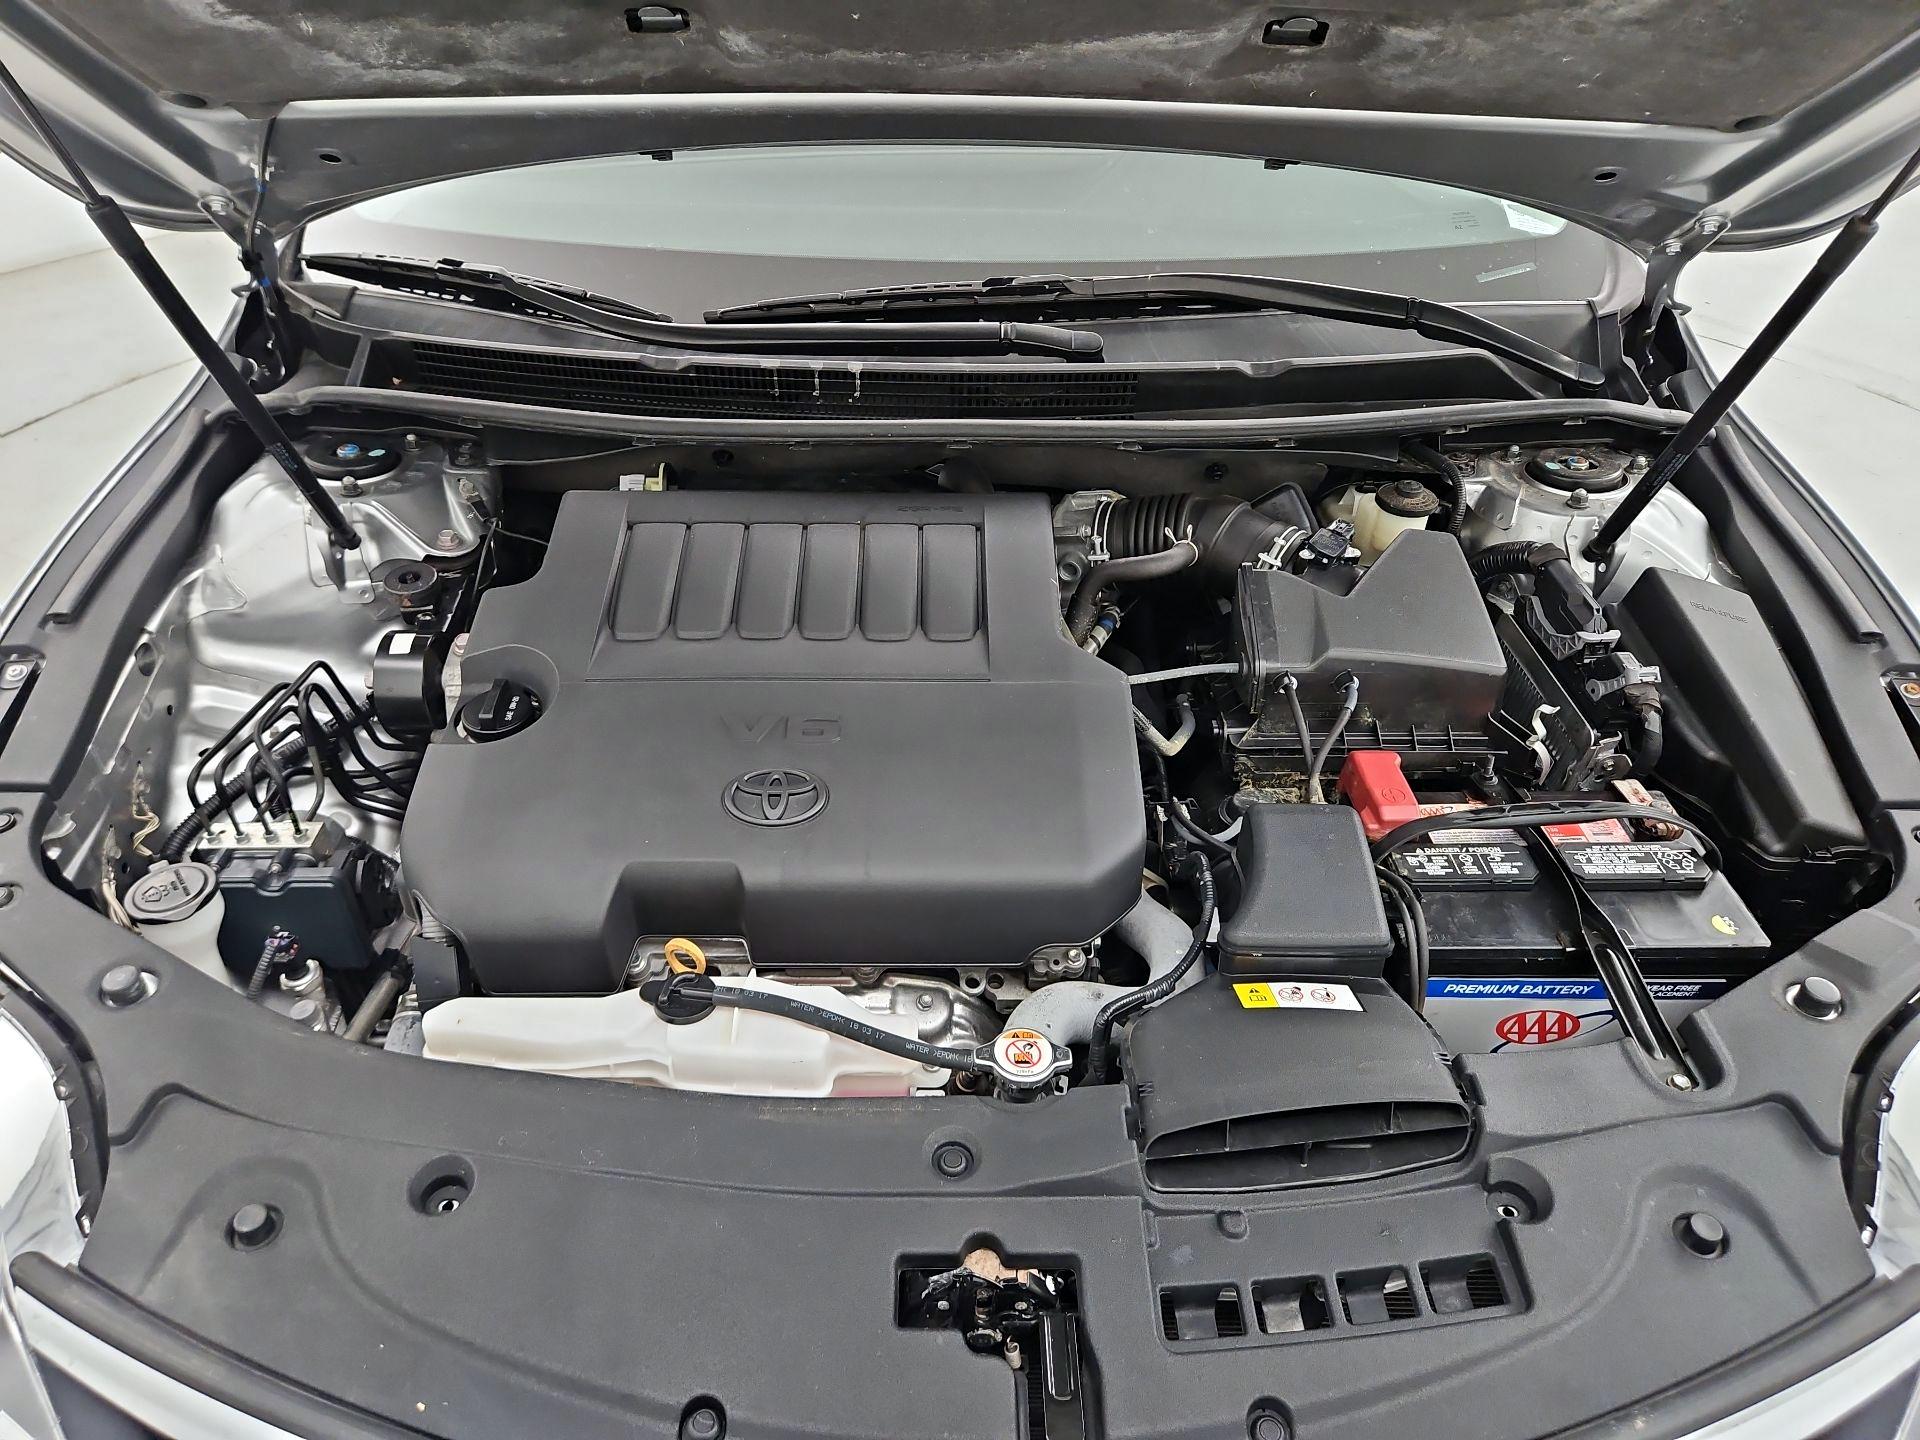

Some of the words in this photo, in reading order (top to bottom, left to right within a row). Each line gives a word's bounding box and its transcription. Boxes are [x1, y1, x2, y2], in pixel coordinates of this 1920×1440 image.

[1443, 983, 1520, 995] PREMIUM
[1523, 985, 1596, 996] BATTERY
[790, 1001, 815, 1013] WATER
[849, 1021, 859, 1030] 18
[862, 1026, 873, 1035] 03
[875, 1031, 886, 1040] 17
[1502, 1011, 1572, 1042] AAA
[905, 1042, 930, 1055] WATER
